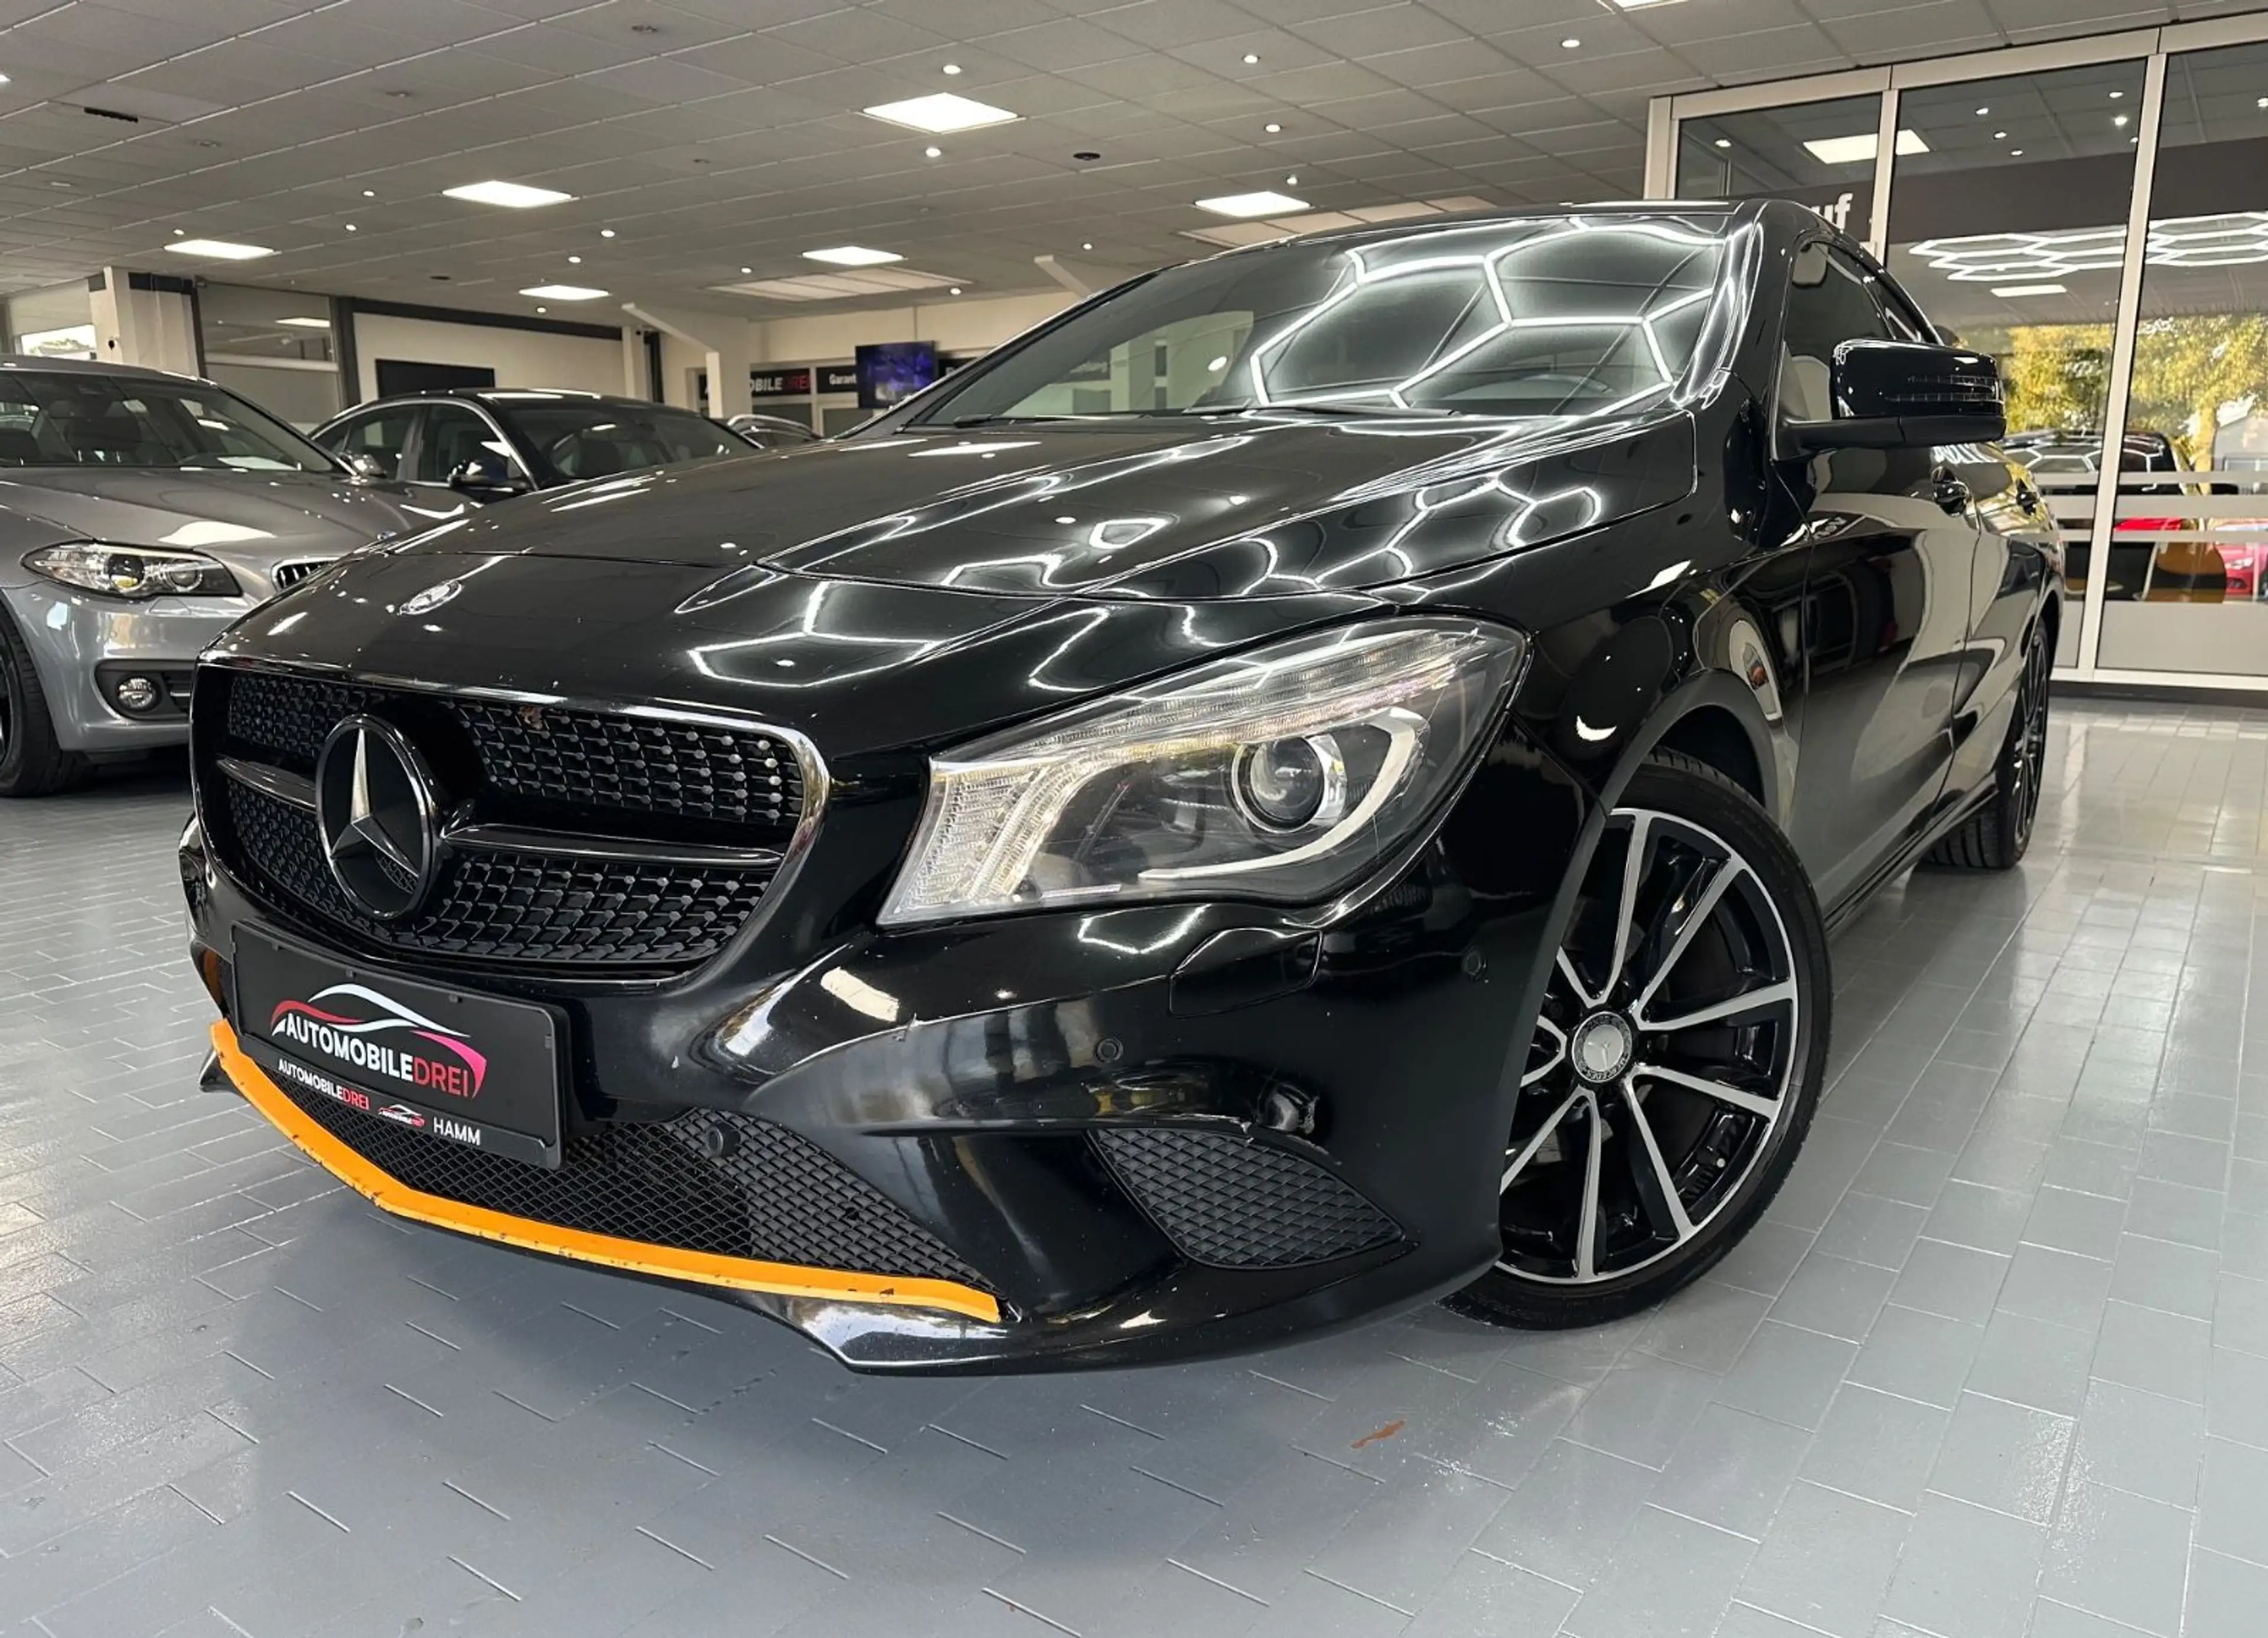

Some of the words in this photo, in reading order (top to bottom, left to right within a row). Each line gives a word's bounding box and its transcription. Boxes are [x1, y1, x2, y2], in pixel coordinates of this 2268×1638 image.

[829, 373, 857, 385] Garant
[286, 1013, 468, 1097] AUTOMOBILEDREI
[278, 1058, 371, 1111] AUTOMOBILEDREI
[434, 1117, 481, 1146] HAMM
